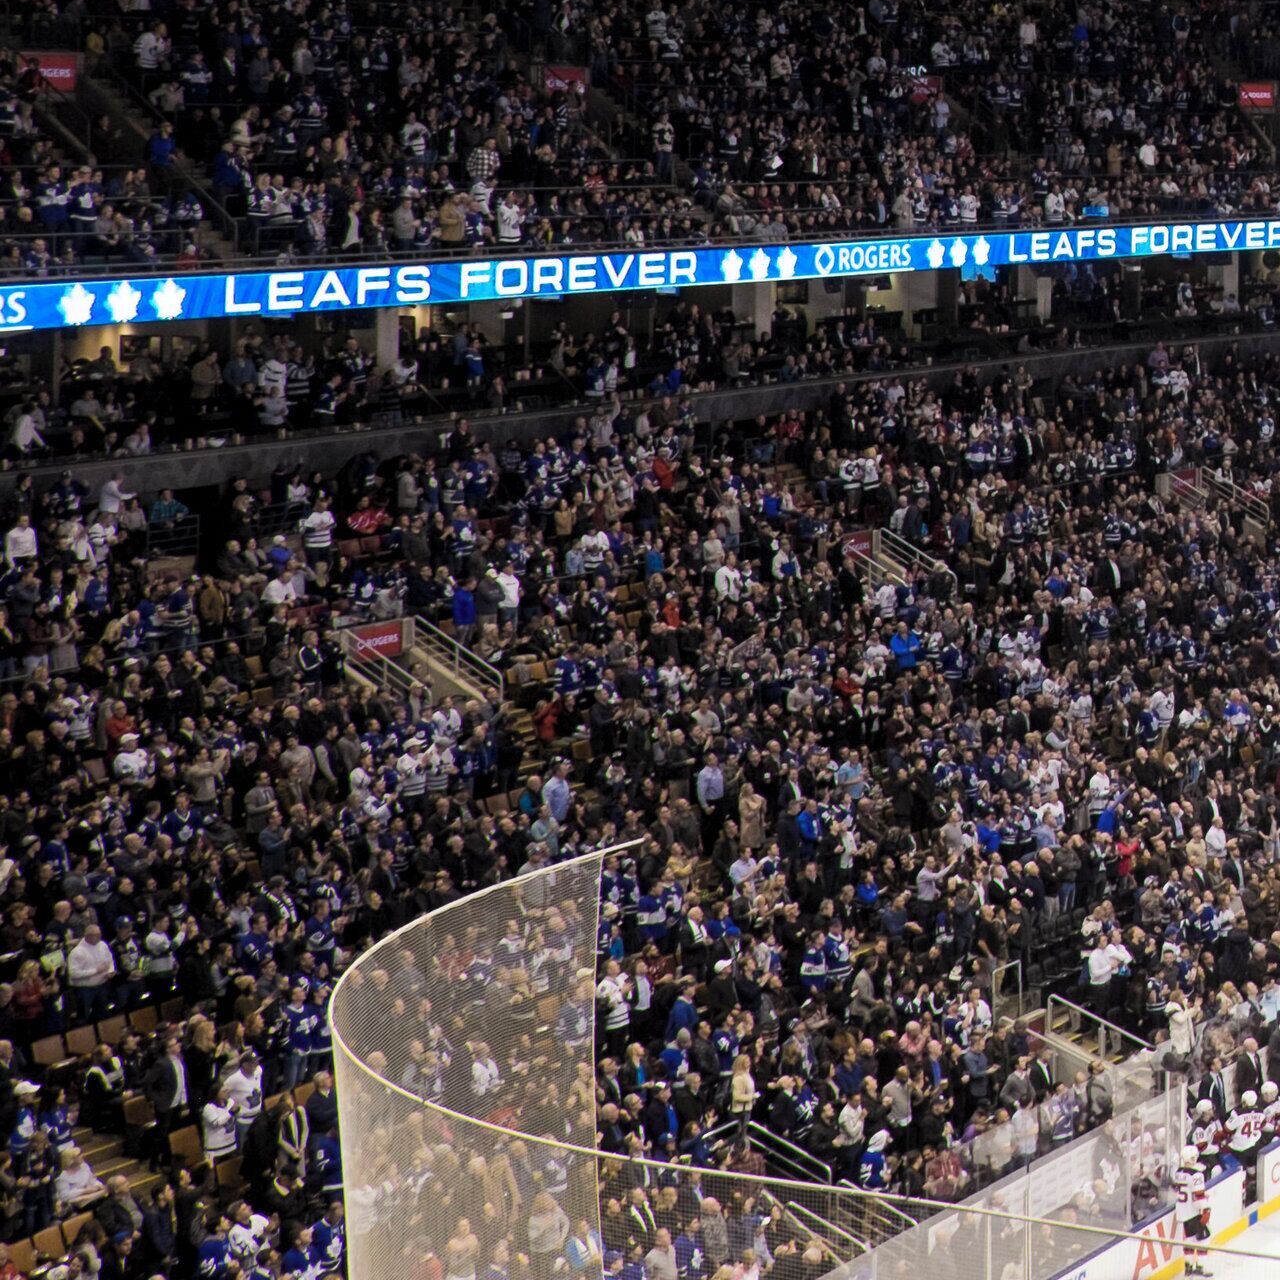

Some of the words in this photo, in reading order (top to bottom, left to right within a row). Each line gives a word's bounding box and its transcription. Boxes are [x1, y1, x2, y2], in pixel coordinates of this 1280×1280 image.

[1248, 91, 1271, 99] ROGERS
[225, 266, 431, 313] LEAFS
[461, 251, 697, 297] FOREVER
[837, 243, 911, 270] ROGERS
[1009, 229, 1116, 261] LEAFS
[368, 634, 400, 647] ROGERS
[1241, 1121, 1261, 1139] 45
[1133, 1215, 1178, 1280] AV
